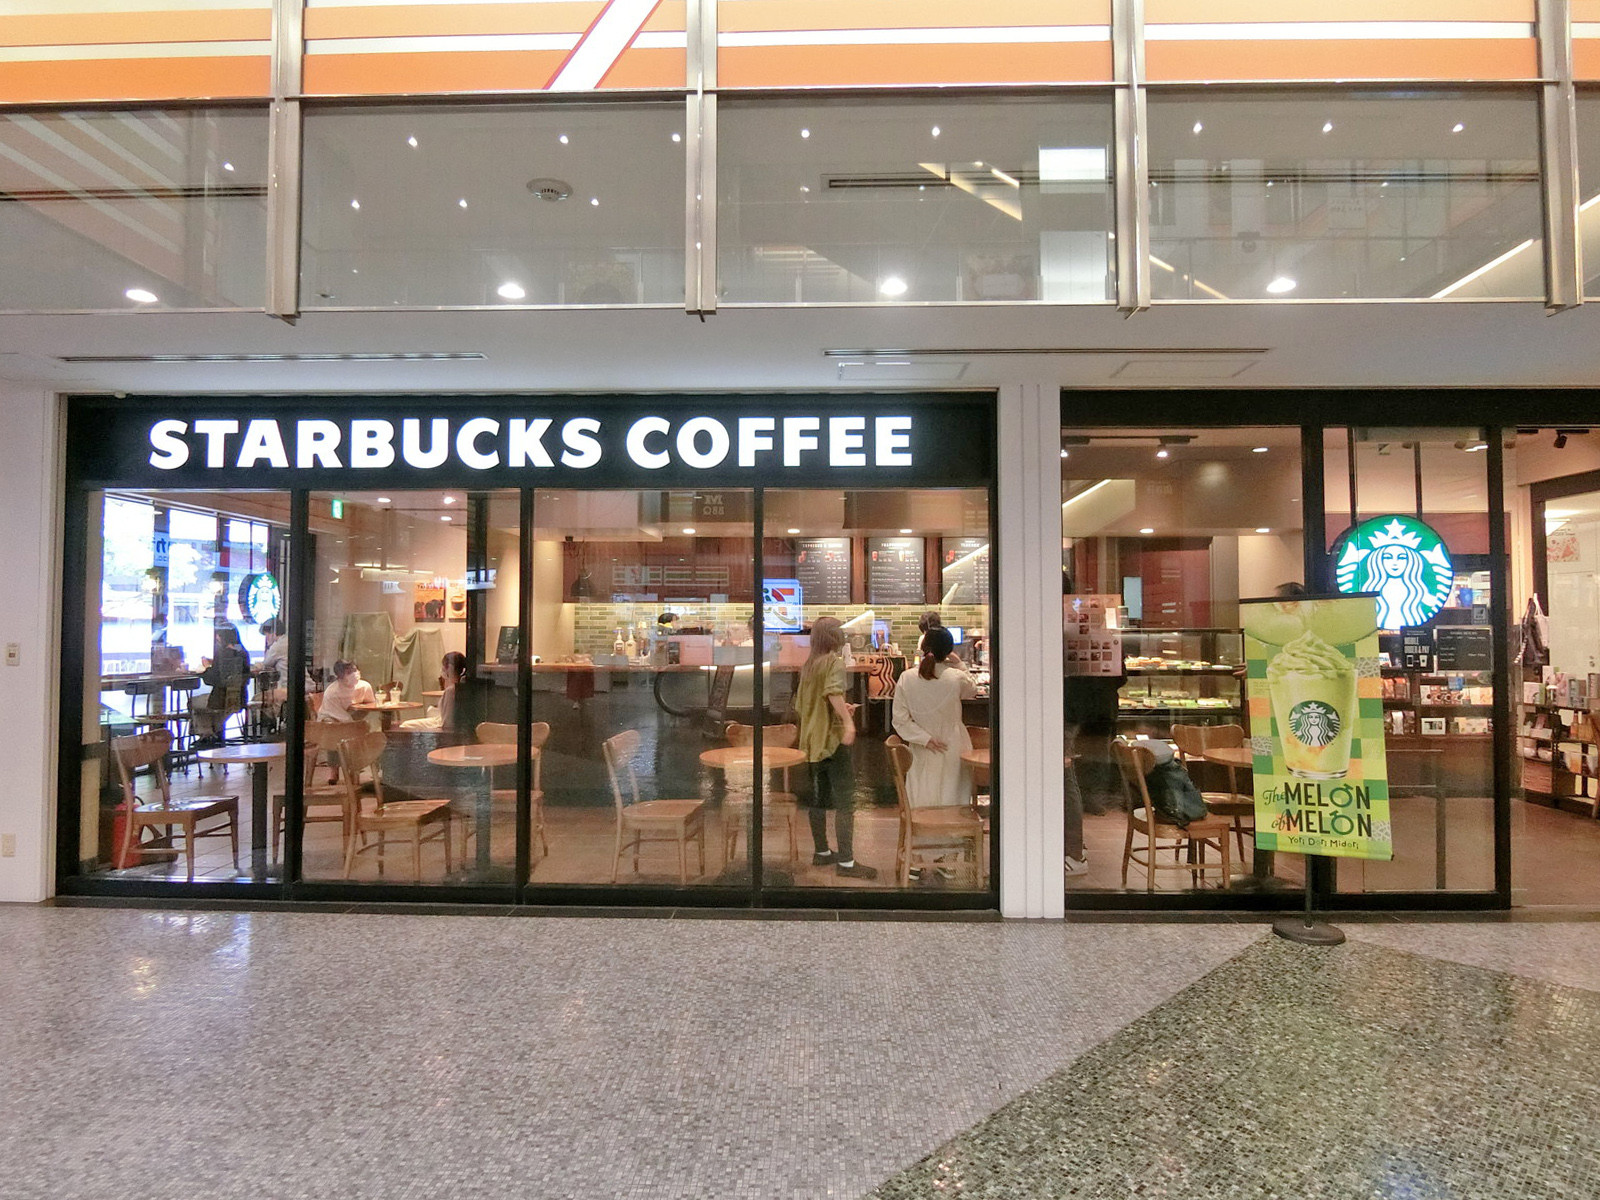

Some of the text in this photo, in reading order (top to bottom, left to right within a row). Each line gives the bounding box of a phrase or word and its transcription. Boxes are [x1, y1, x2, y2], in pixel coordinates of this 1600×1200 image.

[149, 415, 913, 471] STARBUCKS COFFEE
[1262, 782, 1371, 810] The MELON
[1286, 808, 1372, 837] MELON
[1330, 840, 1359, 850] Midori
